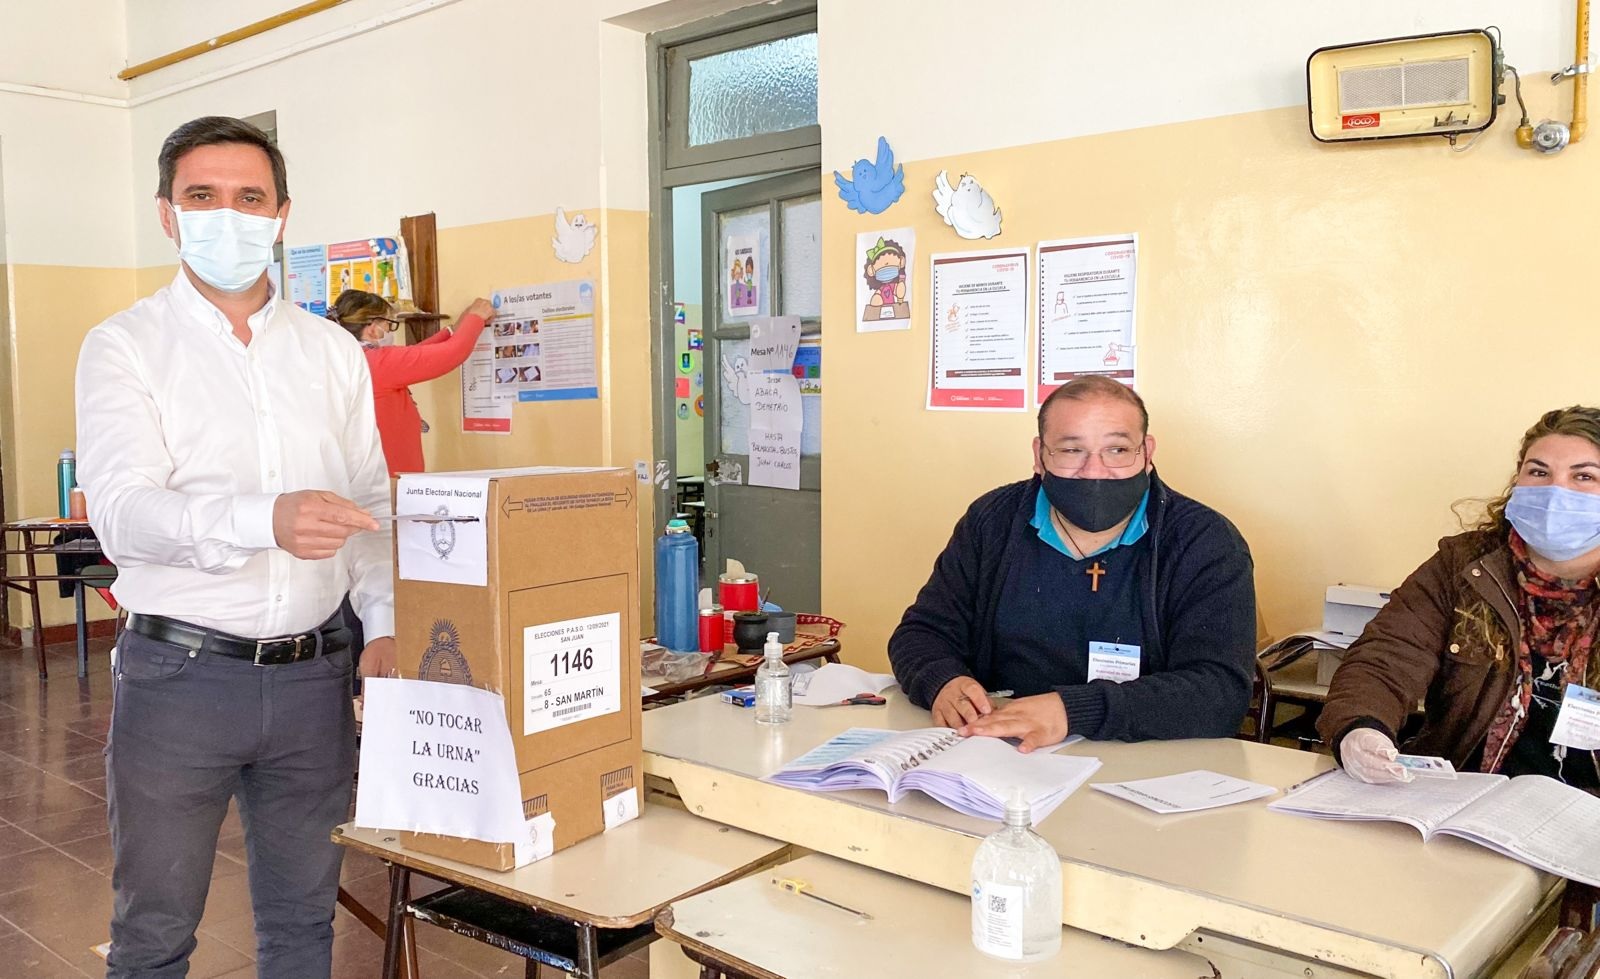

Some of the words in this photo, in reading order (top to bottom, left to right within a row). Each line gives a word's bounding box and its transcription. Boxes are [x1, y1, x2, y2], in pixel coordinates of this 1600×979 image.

[503, 296, 510, 304] A
[509, 293, 525, 304] los/as
[526, 291, 552, 302] votantes
[751, 348, 766, 356] Mesa
[775, 344, 793, 359] 1146
[755, 401, 789, 412] DEMETRIO
[406, 487, 424, 495] Junta
[425, 487, 453, 497] Electoral
[454, 489, 482, 498] Nacional
[534, 628, 565, 640] ELECCIONES
[586, 621, 610, 631] 12/09/2021
[571, 633, 585, 642] JUAN
[550, 647, 594, 677] 1146
[544, 688, 552, 697] 65
[544, 699, 549, 710] 8
[555, 694, 572, 707] SAN
[573, 685, 604, 703] MARTÍN
[409, 709, 434, 726] “NO
[437, 712, 483, 734] TOCAR
[412, 740, 432, 756] LA
[437, 743, 480, 763] URNA”
[413, 772, 480, 795] GRACIAS
